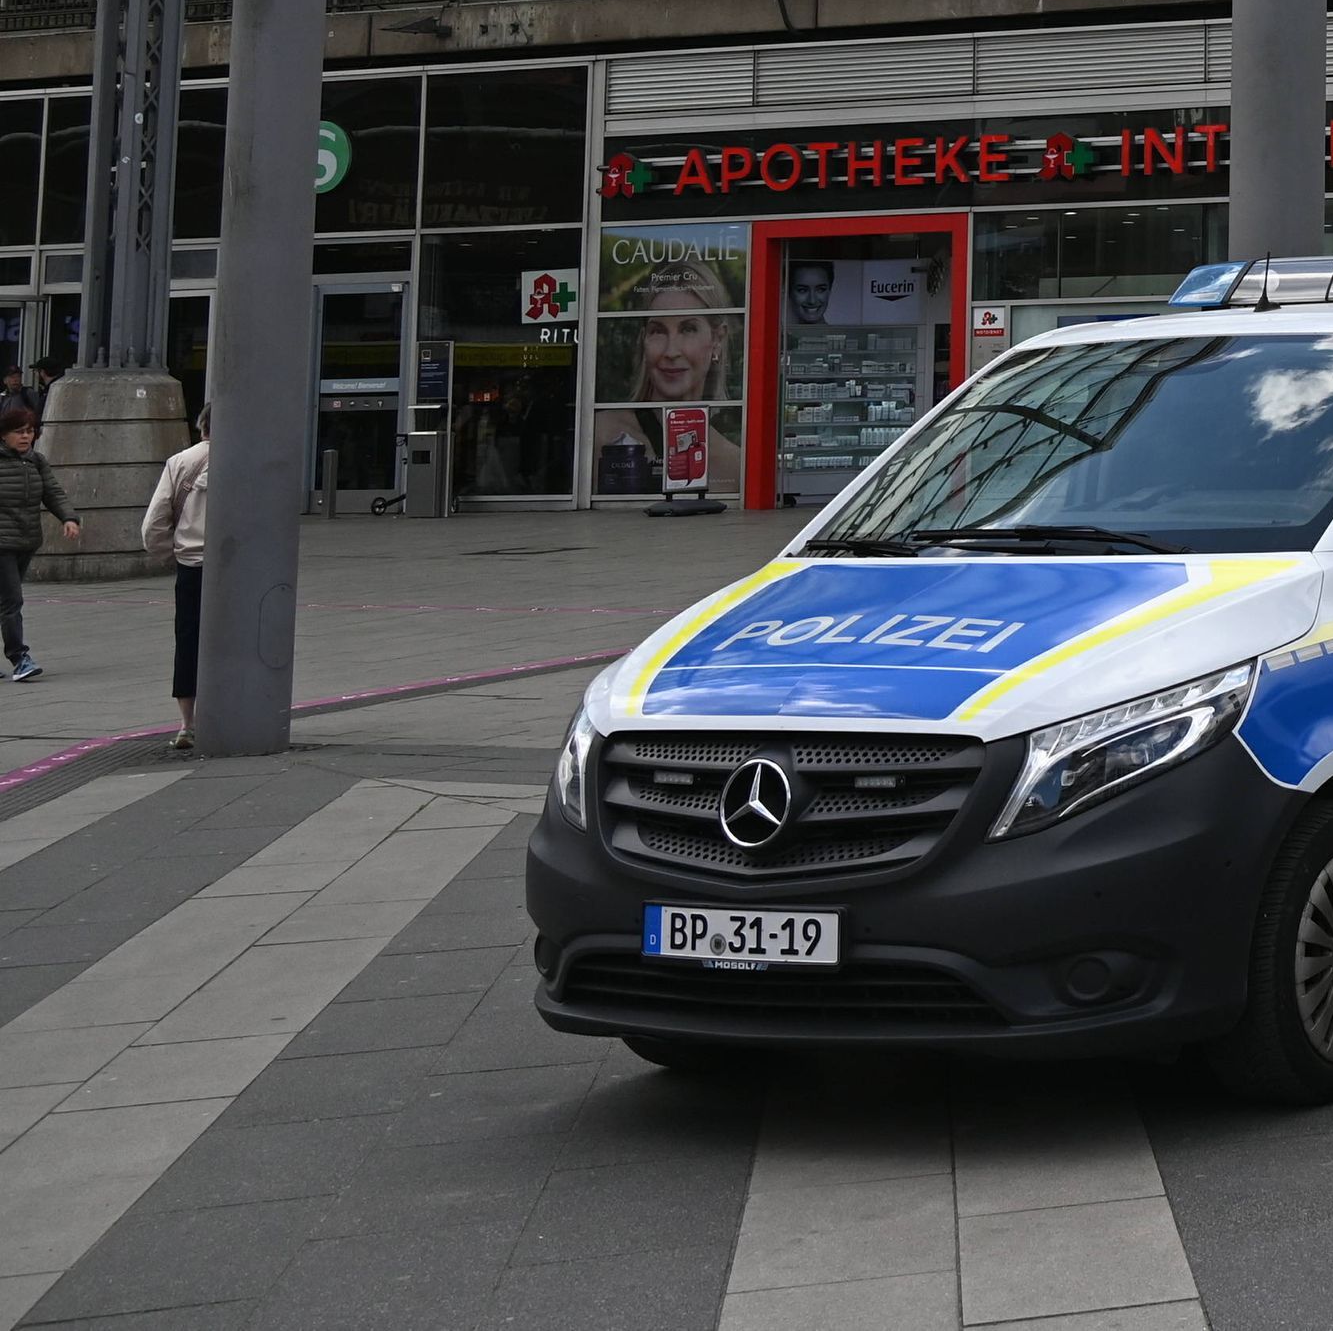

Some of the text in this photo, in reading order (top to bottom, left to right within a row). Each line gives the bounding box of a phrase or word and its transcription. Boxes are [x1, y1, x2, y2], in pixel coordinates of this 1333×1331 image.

[674, 133, 1011, 196] APOTHEKE
[651, 271, 698, 282] Premier Cru
[870, 280, 914, 294] Eucerin
[713, 613, 1027, 654] POLIZEI
[649, 912, 822, 956] D BP 31-19
